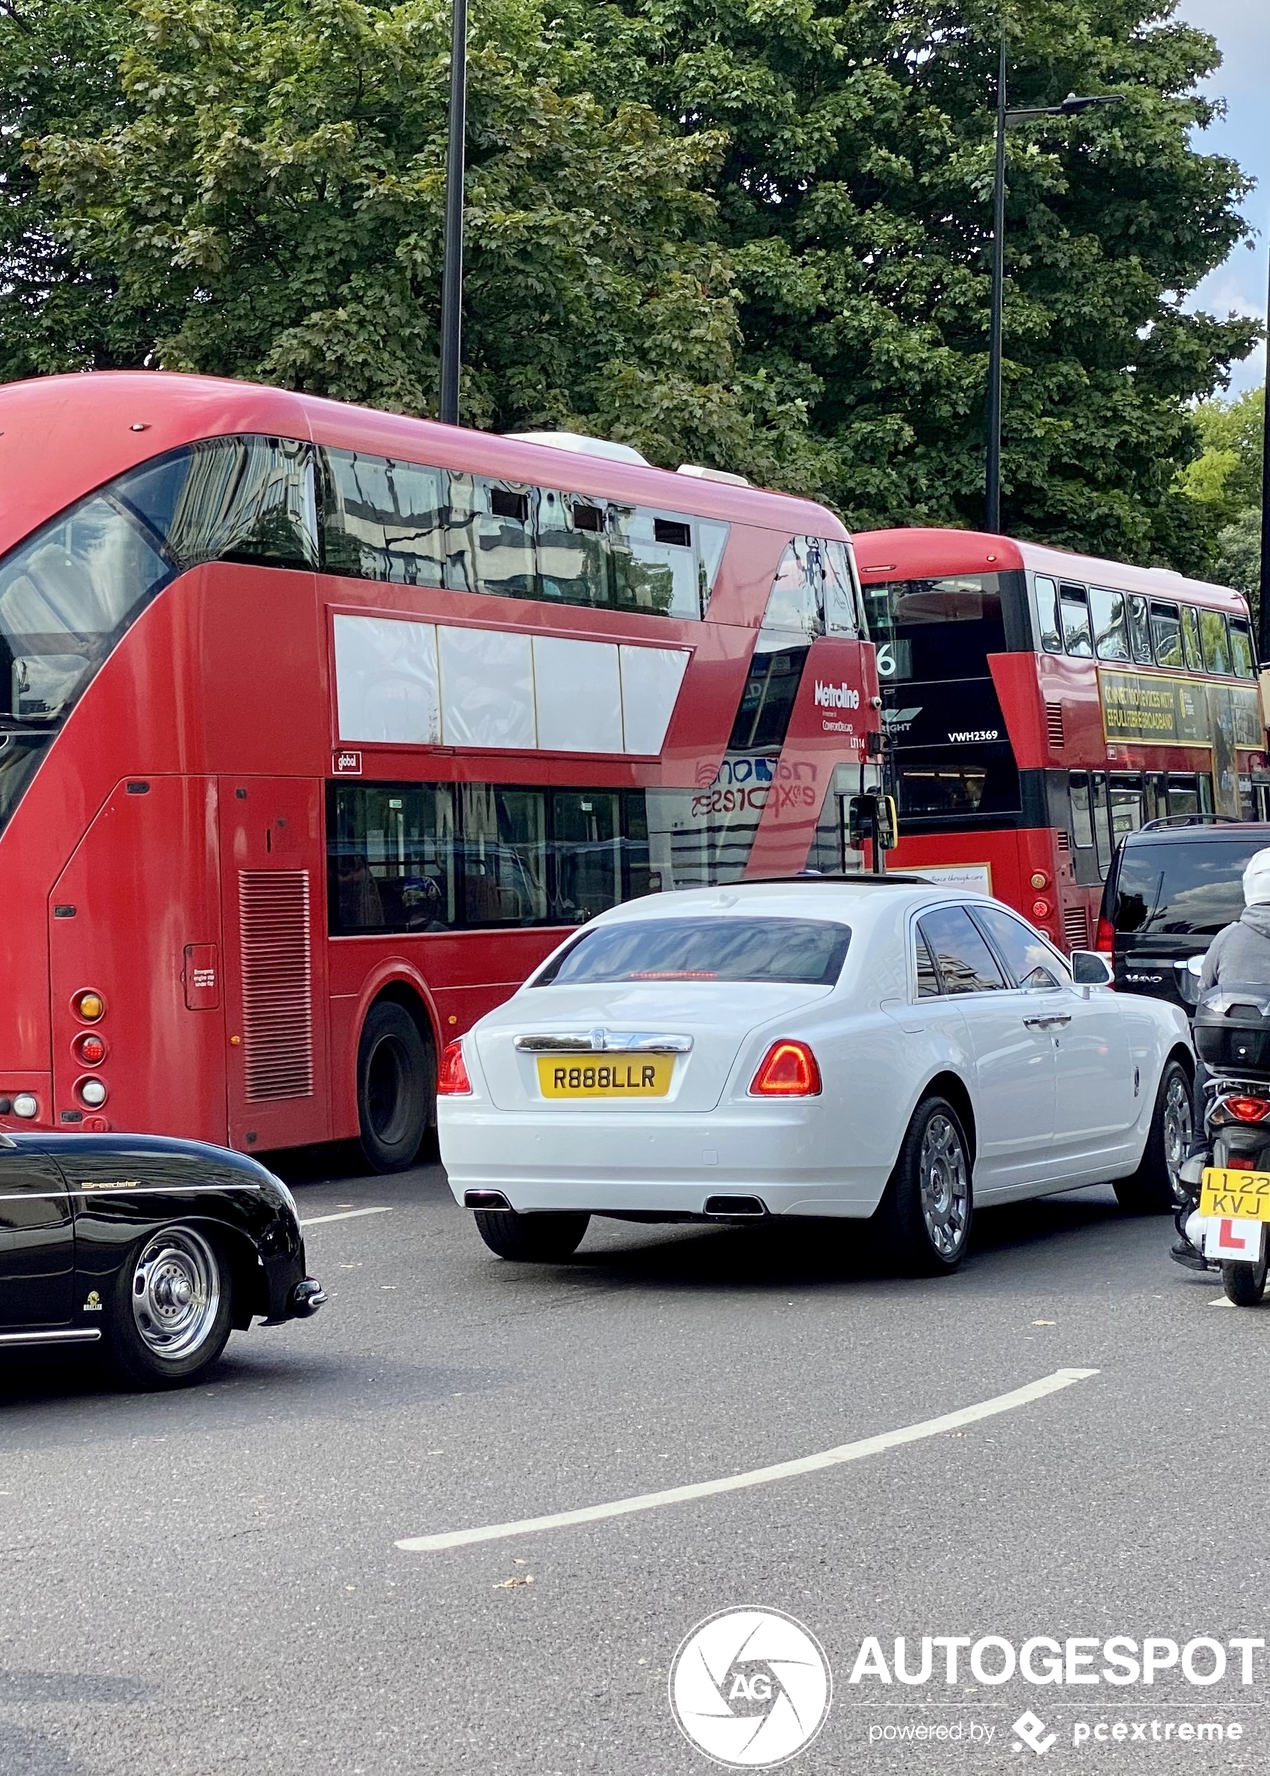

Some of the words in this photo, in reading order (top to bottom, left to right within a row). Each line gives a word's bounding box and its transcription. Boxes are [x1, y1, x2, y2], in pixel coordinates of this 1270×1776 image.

[876, 643, 897, 676] 6
[814, 679, 860, 710] Metroline
[947, 730, 998, 742] VWH2369
[337, 754, 357, 771] global
[553, 1065, 656, 1089] R888LLR
[1206, 1172, 1270, 1195] LL22
[1212, 1194, 1261, 1215] KVJ
[1219, 1218, 1246, 1249] L
